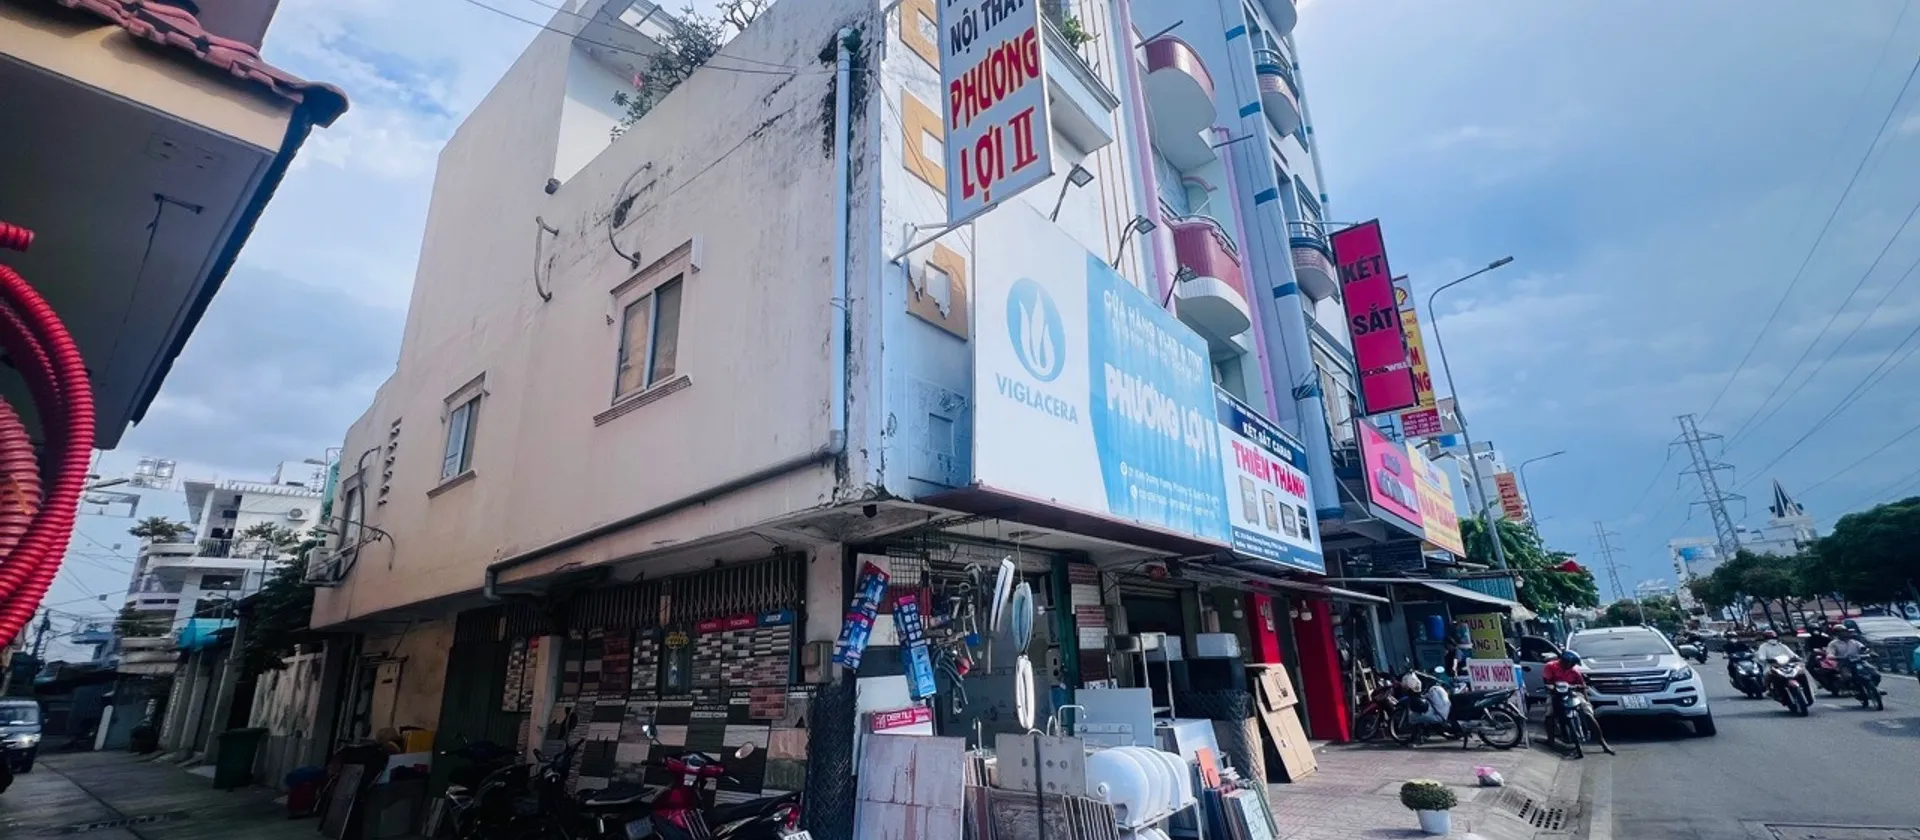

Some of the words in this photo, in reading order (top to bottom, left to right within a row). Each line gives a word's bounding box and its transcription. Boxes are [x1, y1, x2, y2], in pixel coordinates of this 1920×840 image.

[950, 8, 978, 56] NỘI
[981, 0, 1024, 32] TH
[950, 27, 1039, 130] PHƯƠNG
[961, 125, 1004, 203] LỢI
[1008, 106, 1038, 173] II
[1341, 255, 1381, 284] KÉT
[1353, 303, 1393, 335] SẮT
[995, 372, 1079, 424] VIGLACERA
[1104, 362, 1180, 441] PHƯƠNG
[1181, 405, 1206, 462] LỢI
[1232, 439, 1270, 483] THIÊN
[1271, 461, 1305, 499] THÀNH
[1470, 664, 1491, 682] THAY
